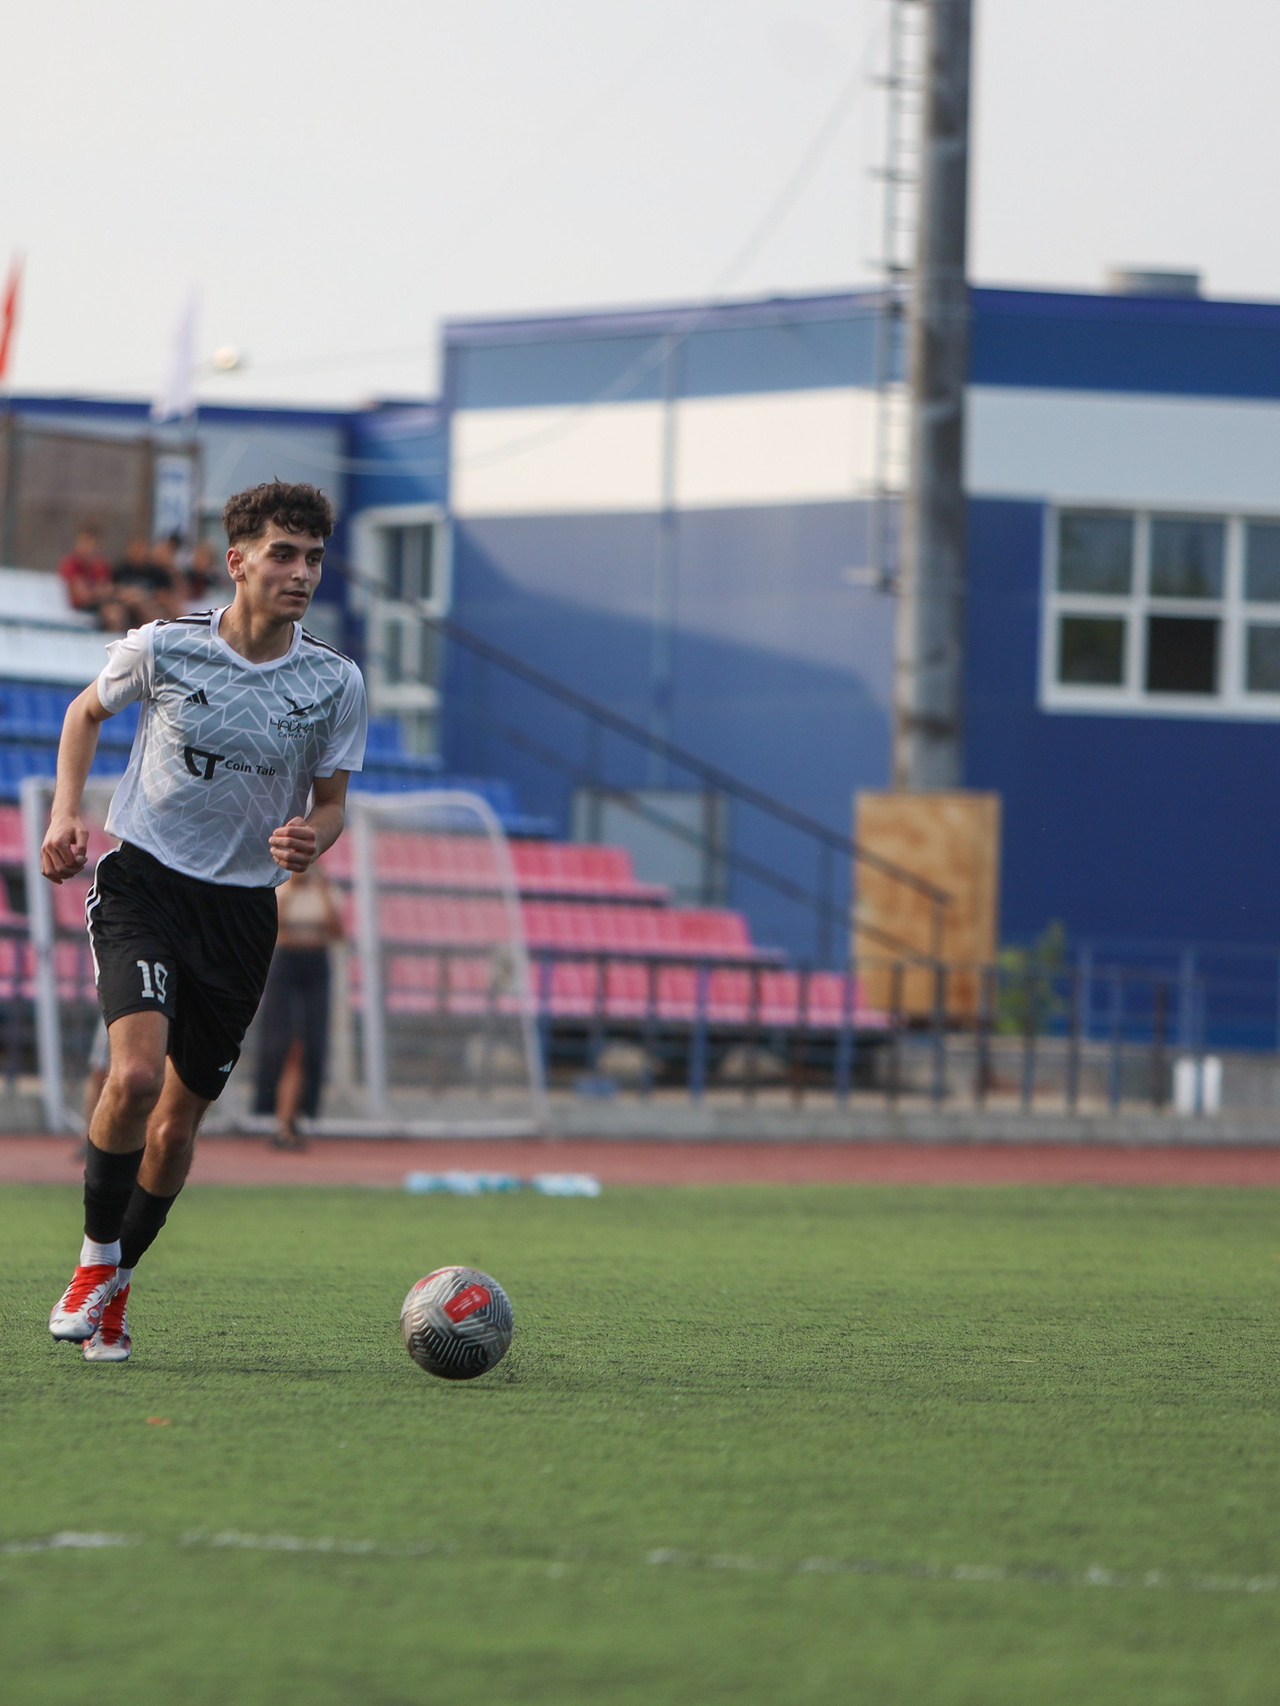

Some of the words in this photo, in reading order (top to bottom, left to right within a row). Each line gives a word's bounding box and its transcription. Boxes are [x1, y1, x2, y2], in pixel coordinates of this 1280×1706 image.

[270, 718, 315, 733] ЧАЙКА
[225, 760, 252, 773] Coin
[255, 764, 276, 777] Tab
